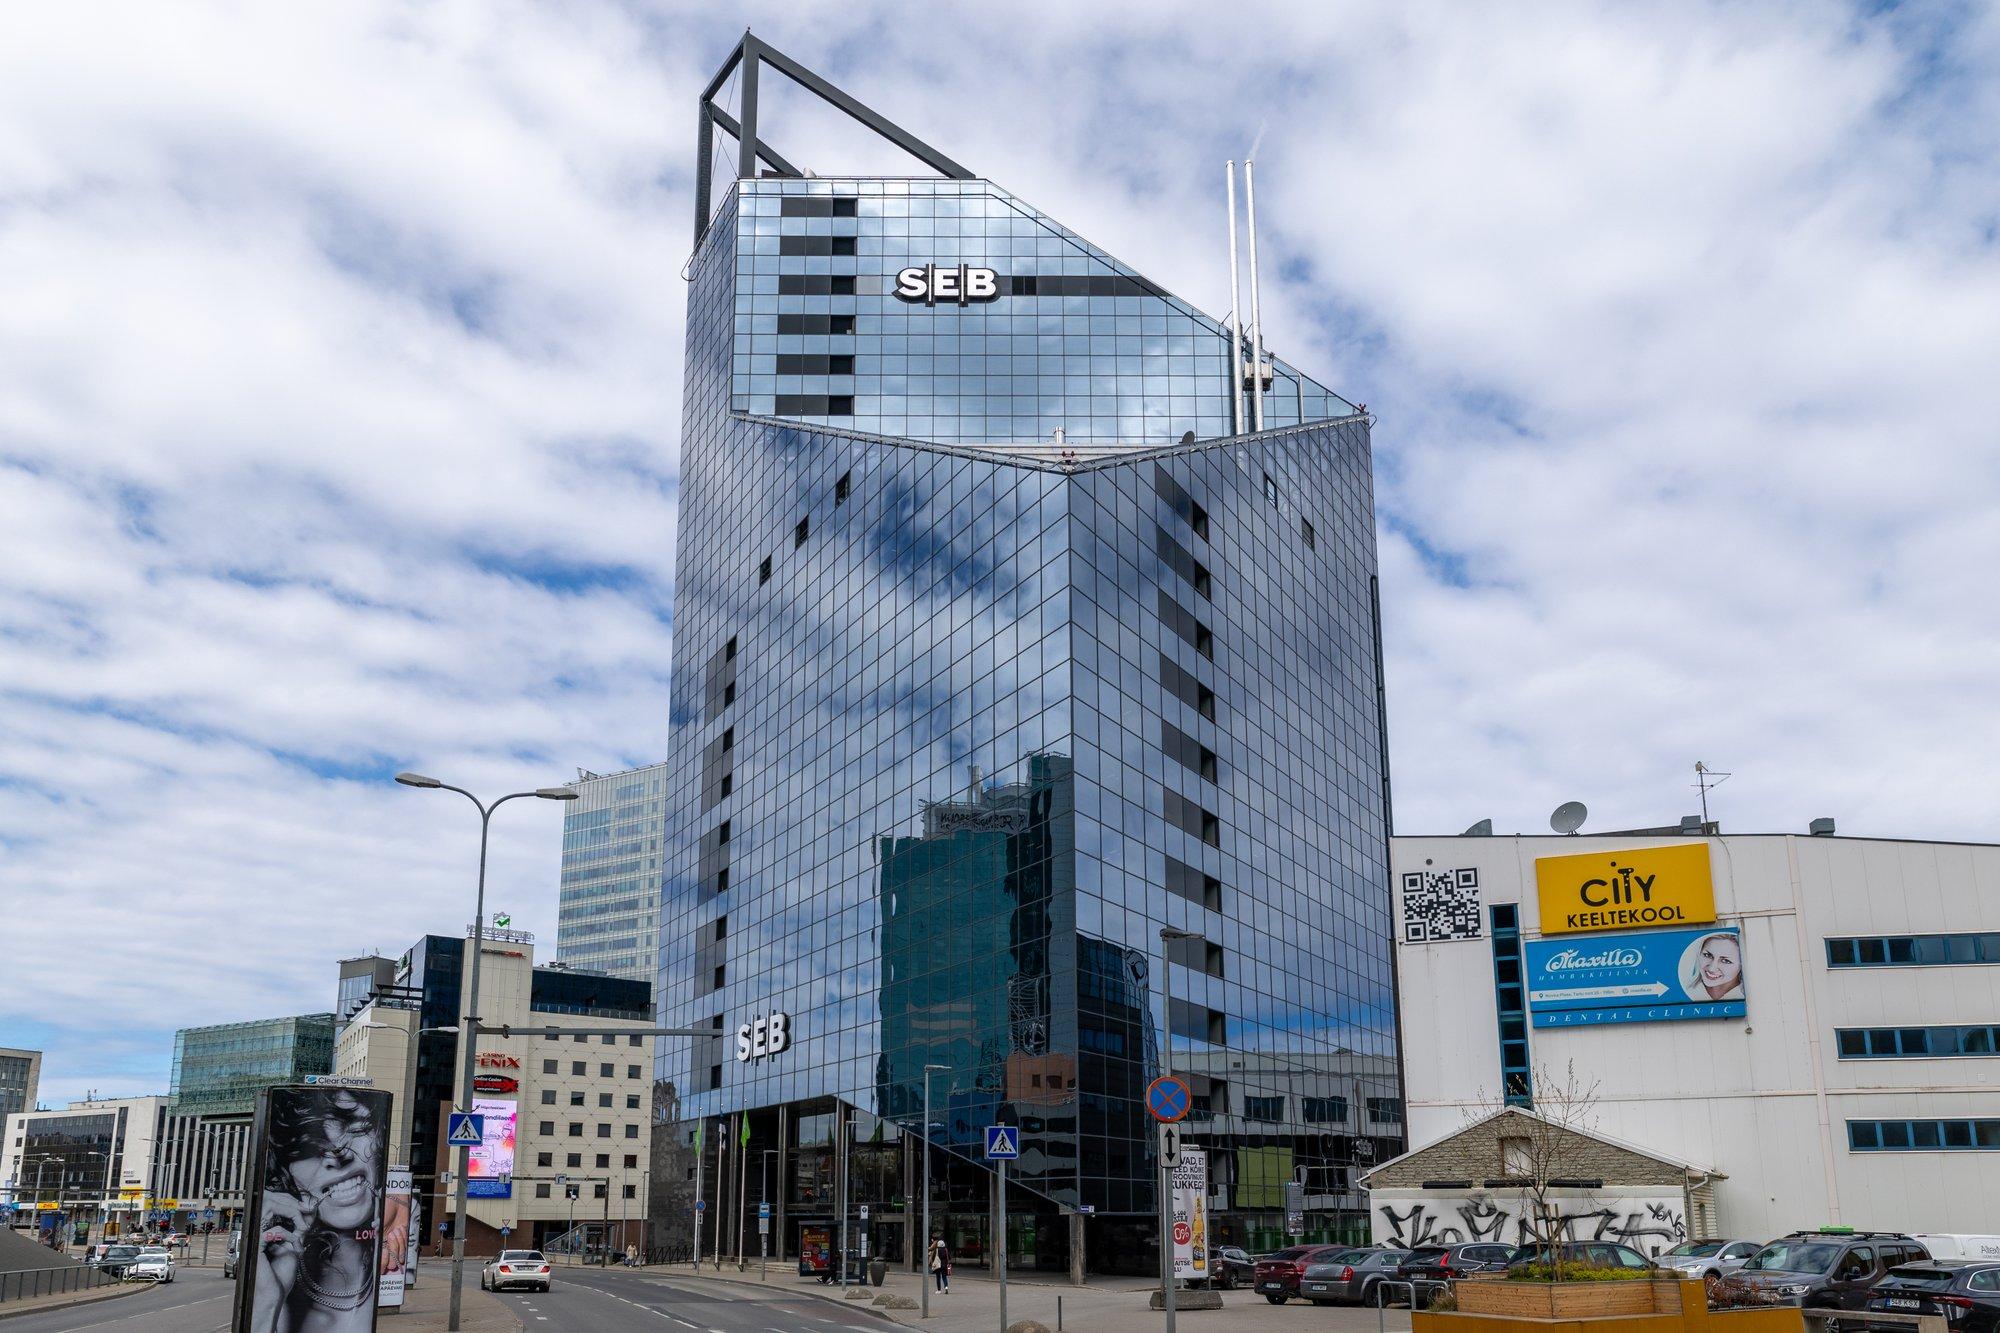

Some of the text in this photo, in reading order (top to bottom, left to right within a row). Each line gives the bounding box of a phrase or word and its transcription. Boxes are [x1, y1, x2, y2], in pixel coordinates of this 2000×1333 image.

[898, 266, 997, 298] SEB
[1567, 905, 1685, 928] KEELTEKOOL
[1548, 949, 1639, 971] Maxilla
[1549, 1005, 1732, 1023] DENTAL CLINIC
[737, 1012, 788, 1062] SEB
[318, 1076, 373, 1086] Clear Channel
